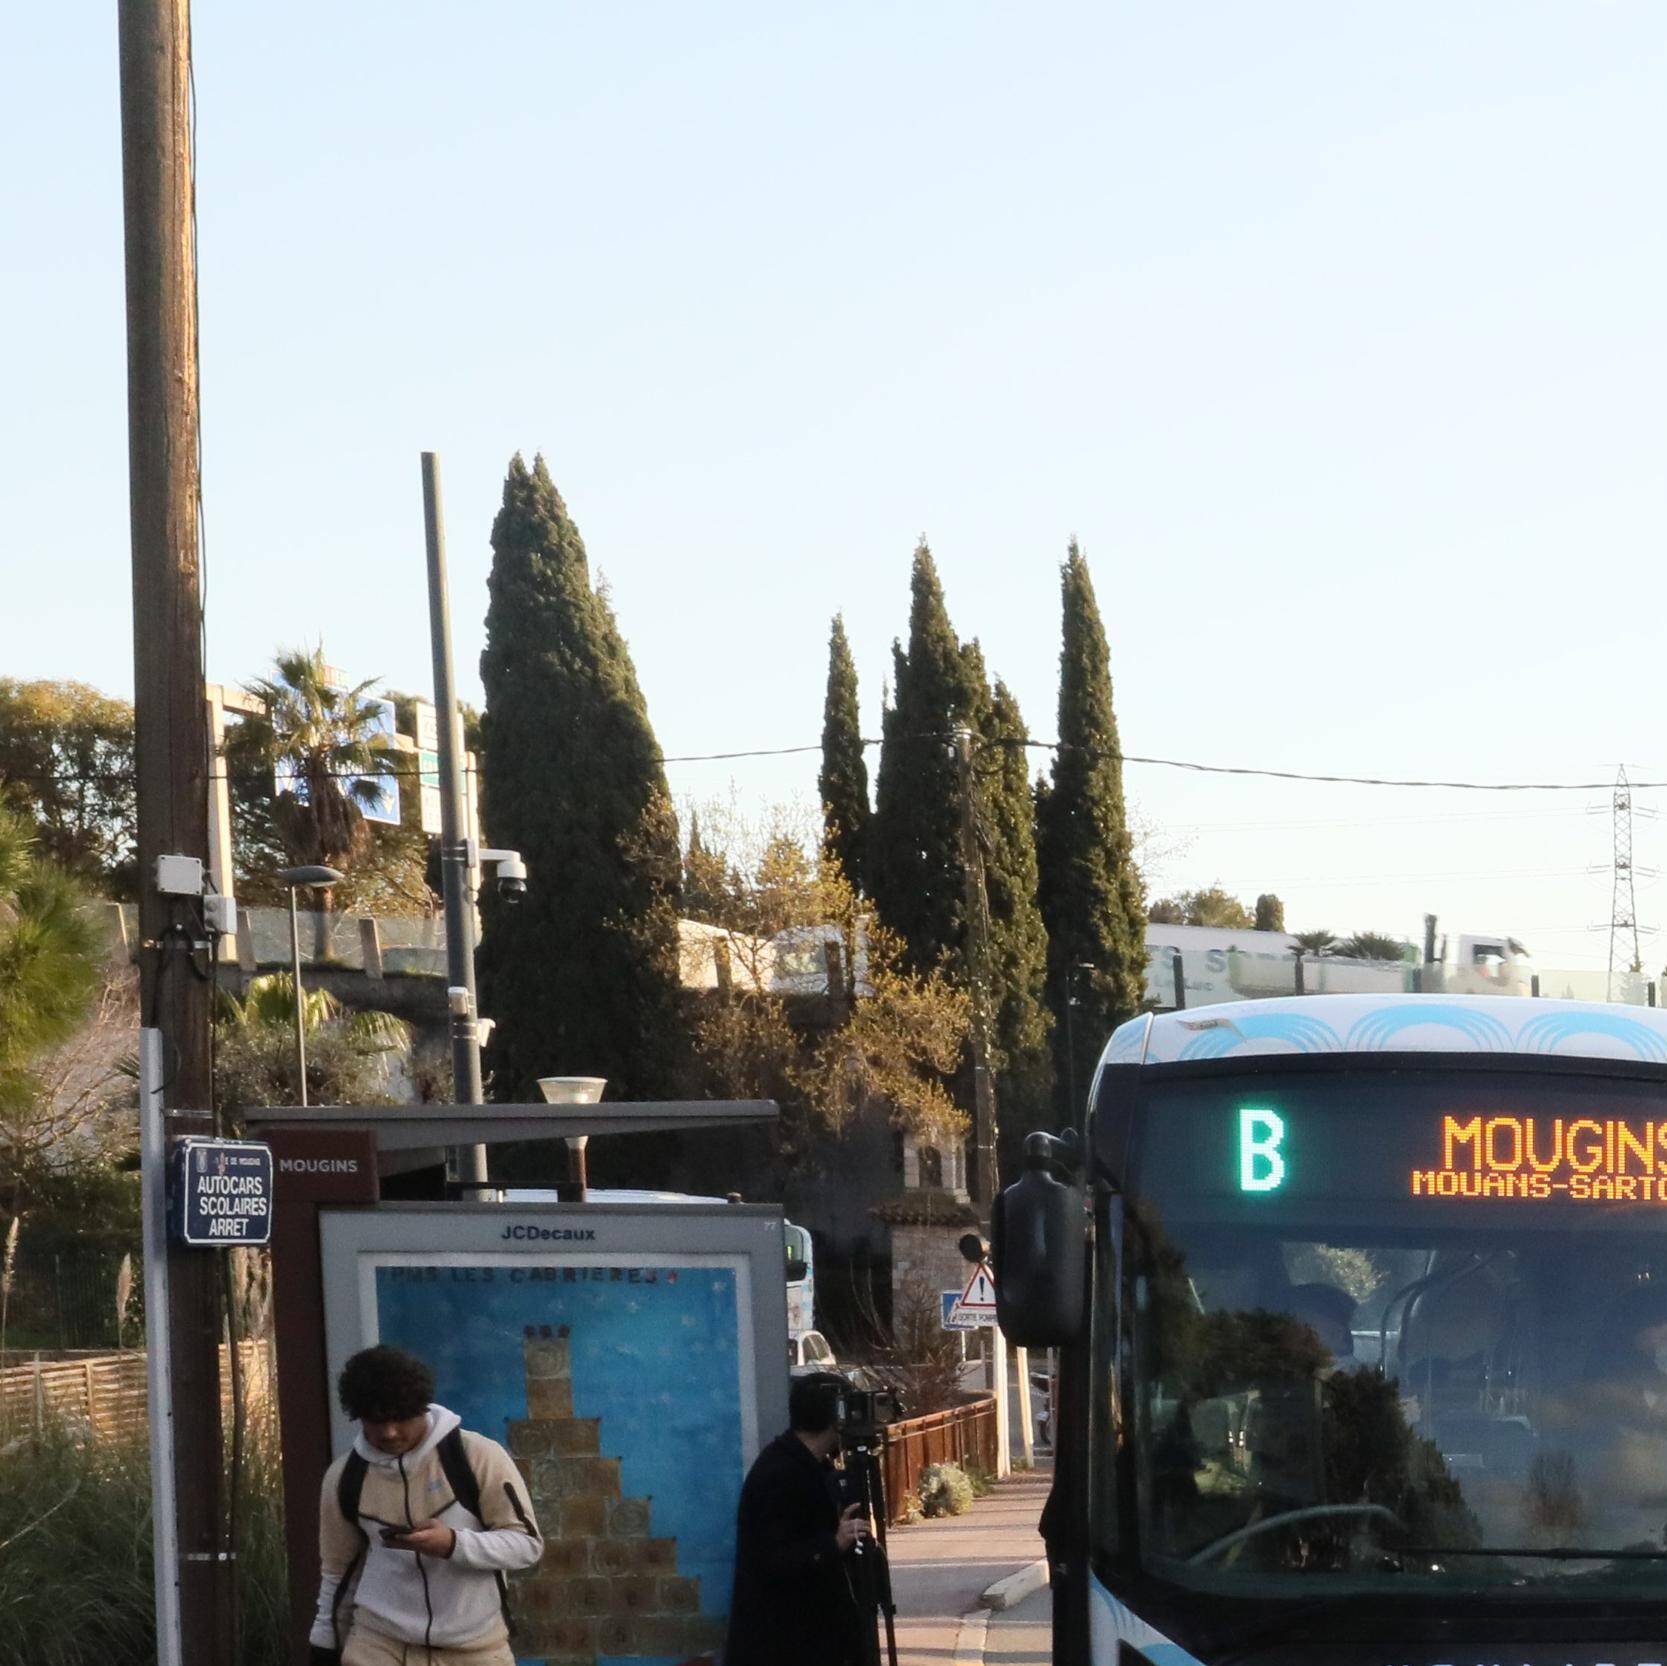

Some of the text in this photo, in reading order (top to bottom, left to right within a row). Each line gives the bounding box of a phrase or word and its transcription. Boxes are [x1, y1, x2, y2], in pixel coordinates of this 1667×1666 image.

[1239, 1109, 1285, 1191] B
[279, 1159, 358, 1173] MOUGINS
[197, 1176, 263, 1194] AUTOCARS
[199, 1197, 267, 1216] SCOLAIRES
[208, 1218, 249, 1236] ARRET
[501, 1225, 596, 1241] JCDecaux
